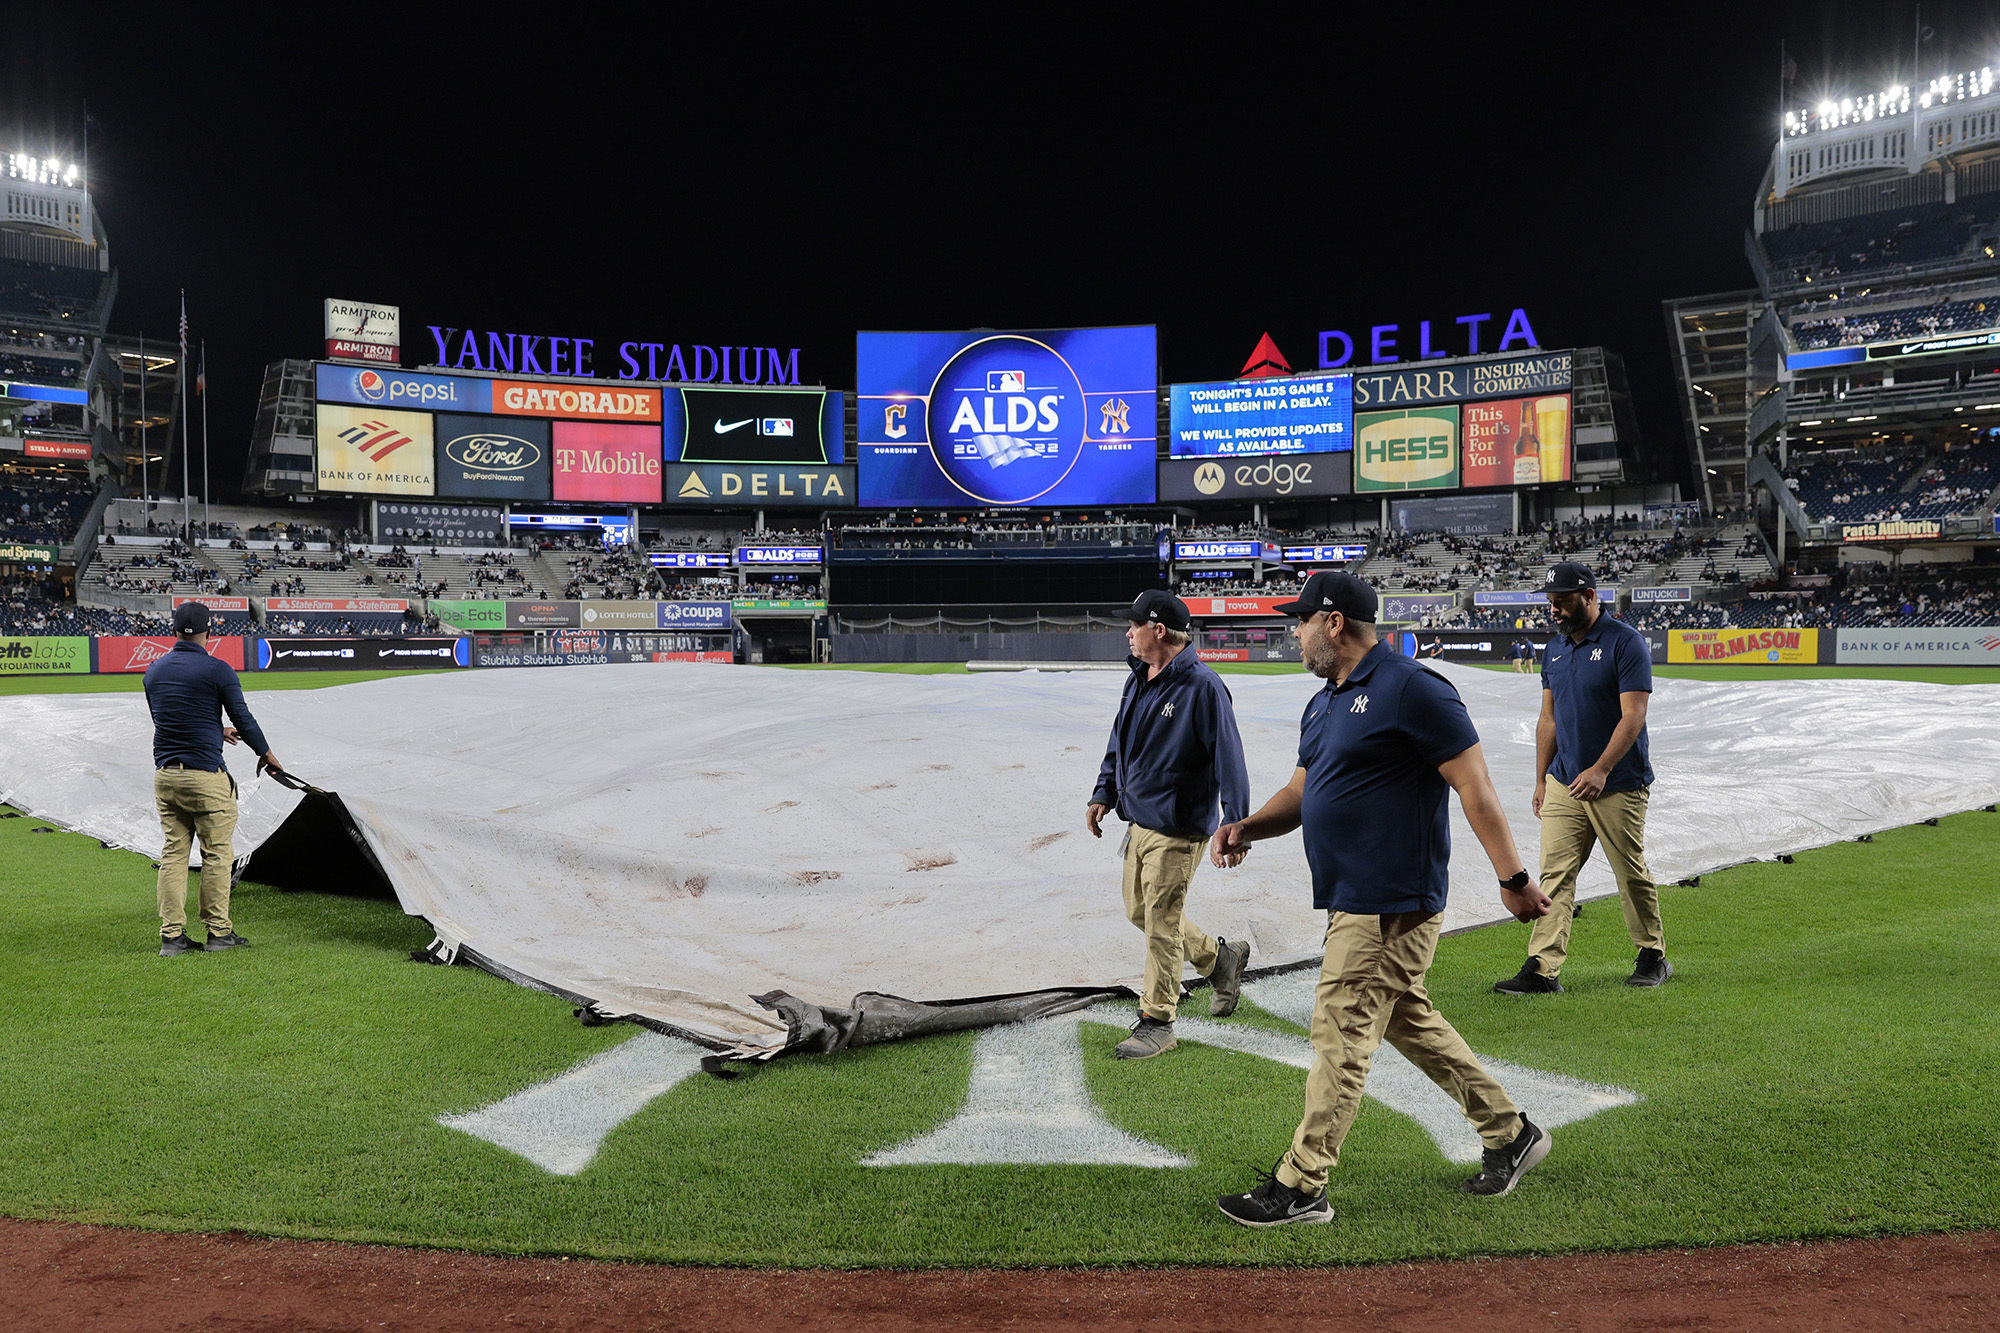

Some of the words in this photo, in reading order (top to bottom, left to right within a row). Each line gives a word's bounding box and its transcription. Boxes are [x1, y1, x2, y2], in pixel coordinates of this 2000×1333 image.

[331, 305, 396, 321] ARMITRON
[1317, 308, 1538, 369] DELTA
[334, 341, 393, 356] ARMITRON
[427, 325, 595, 378] YANKEE
[618, 341, 801, 386] STADIUM
[363, 352, 392, 361] WATCHES
[1473, 355, 1571, 381] INSURANCE
[1354, 370, 1462, 405] STARR
[1472, 370, 1571, 395] COMPANIES
[389, 380, 455, 403] pepsi
[1189, 388, 1252, 401] TONIGHT'S
[1254, 385, 1286, 398] ALDS
[1288, 383, 1324, 395] GAME
[1326, 382, 1334, 393] 5
[504, 387, 651, 416] GATORADE
[1192, 403, 1223, 414] WILL
[1224, 401, 1261, 412] BEGIN
[1263, 399, 1276, 410] IN
[1278, 398, 1289, 409] A
[1290, 396, 1332, 408] DELAY.
[948, 395, 1059, 434] ALDS
[1099, 398, 1132, 434] NY
[1468, 407, 1504, 421] This
[1180, 430, 1200, 441] WE
[1202, 428, 1233, 440] WILL
[1235, 425, 1287, 439] PROVIDE
[1289, 422, 1344, 435] UPDATES
[1468, 421, 1511, 437] Bud's
[29, 445, 56, 453] STELLA
[61, 447, 88, 455] ARTOIS
[462, 437, 524, 466] Ford
[1098, 443, 1132, 451] YANKEES
[1218, 442, 1234, 453] AS
[1236, 438, 1305, 451] AVAILABLE.
[1365, 435, 1449, 464] HESS
[1468, 440, 1495, 452] For
[580, 450, 659, 476] Mobile
[1468, 453, 1503, 467] You.
[320, 470, 354, 480] BANK
[357, 472, 372, 481] OF
[376, 473, 430, 484] AMERICA
[462, 472, 525, 482] BuyFordNow.com
[1234, 457, 1313, 495] edge
[721, 472, 845, 497] DELTA
[1444, 526, 1463, 534] THE
[1465, 524, 1489, 534] BOSS
[1842, 524, 1876, 537] Parts
[1877, 520, 1940, 535] Authority
[15, 546, 50, 562] Spring
[764, 550, 795, 561] ALDS
[1195, 544, 1227, 557] ALDS
[701, 577, 731, 585] TERRACE
[1636, 591, 1679, 599] UNTUCKit
[682, 605, 723, 621] coupa
[1227, 602, 1259, 610] TOYOTA
[468, 608, 503, 621] Eats
[1682, 632, 1701, 642] WHO
[1702, 632, 1718, 641] BUT
[33, 640, 77, 659] Labs
[1841, 641, 1878, 651] BANK
[1882, 641, 1901, 651] OF
[1904, 641, 1970, 651] AMERICA
[51, 662, 71, 670] BAR
[480, 655, 520, 666] StubHub
[523, 654, 563, 665] StubHub
[567, 654, 608, 664] StubHub
